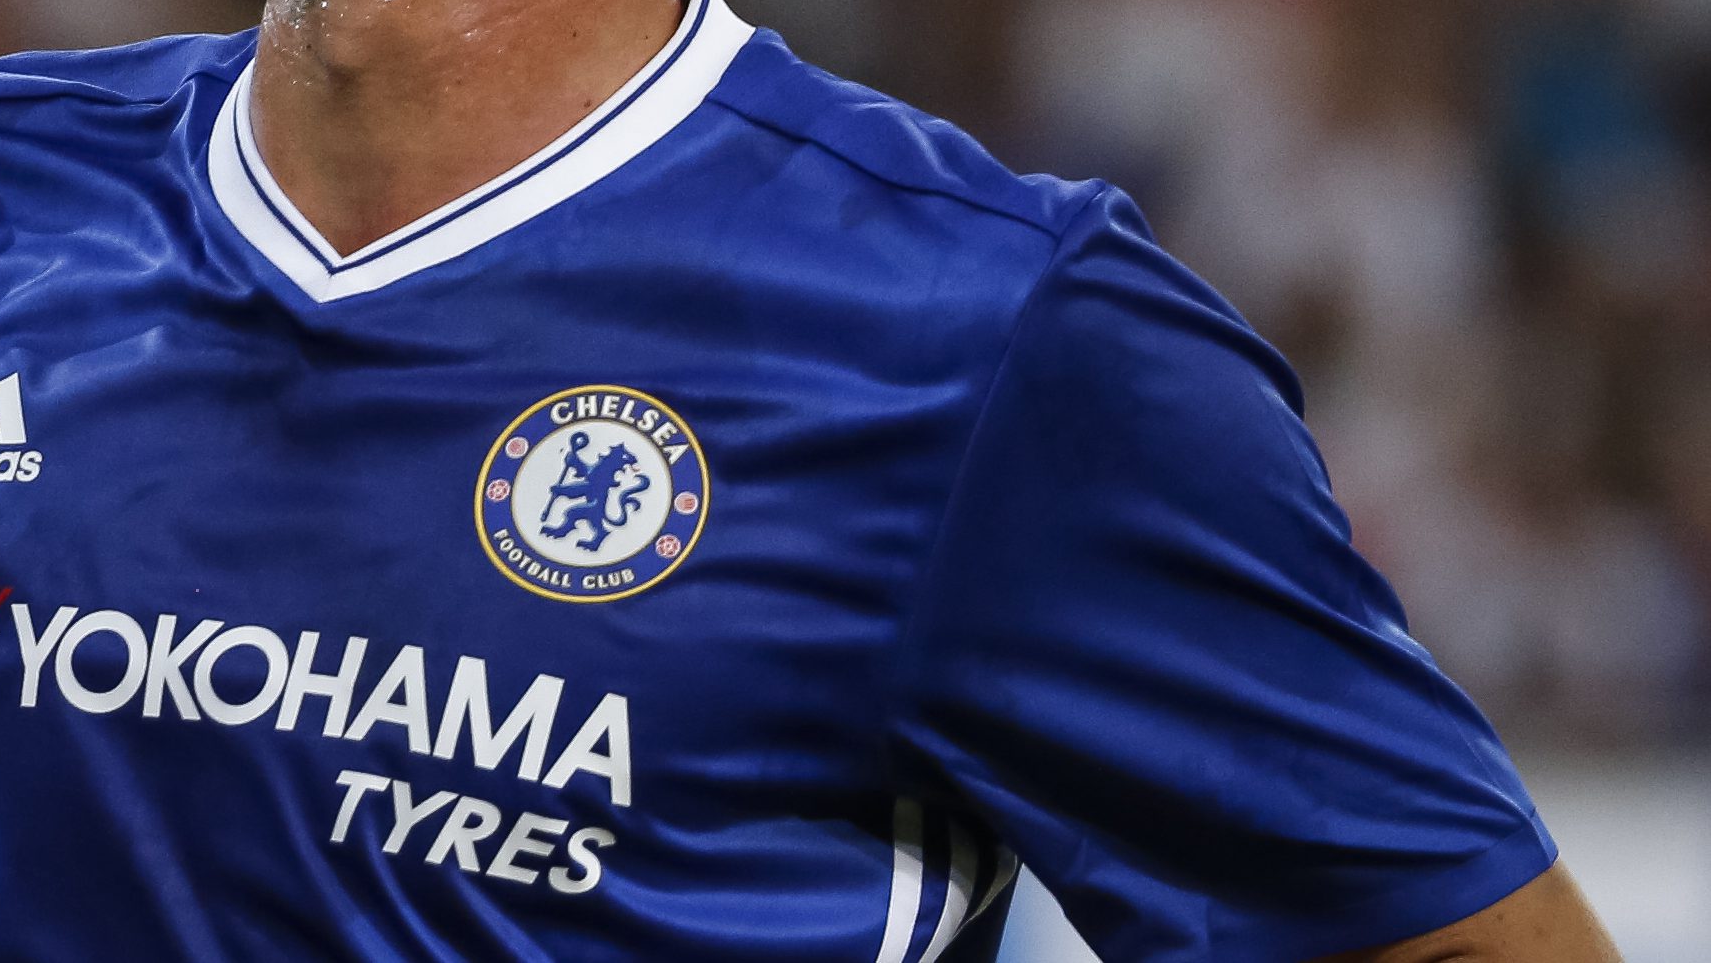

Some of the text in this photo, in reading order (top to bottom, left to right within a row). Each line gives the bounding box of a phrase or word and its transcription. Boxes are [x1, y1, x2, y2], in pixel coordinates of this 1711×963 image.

[549, 394, 691, 465] CHELSEA
[493, 528, 636, 590] FOOTBALL CLUB
[10, 602, 633, 807] YOKOHAMA
[329, 769, 617, 894] TYRES
